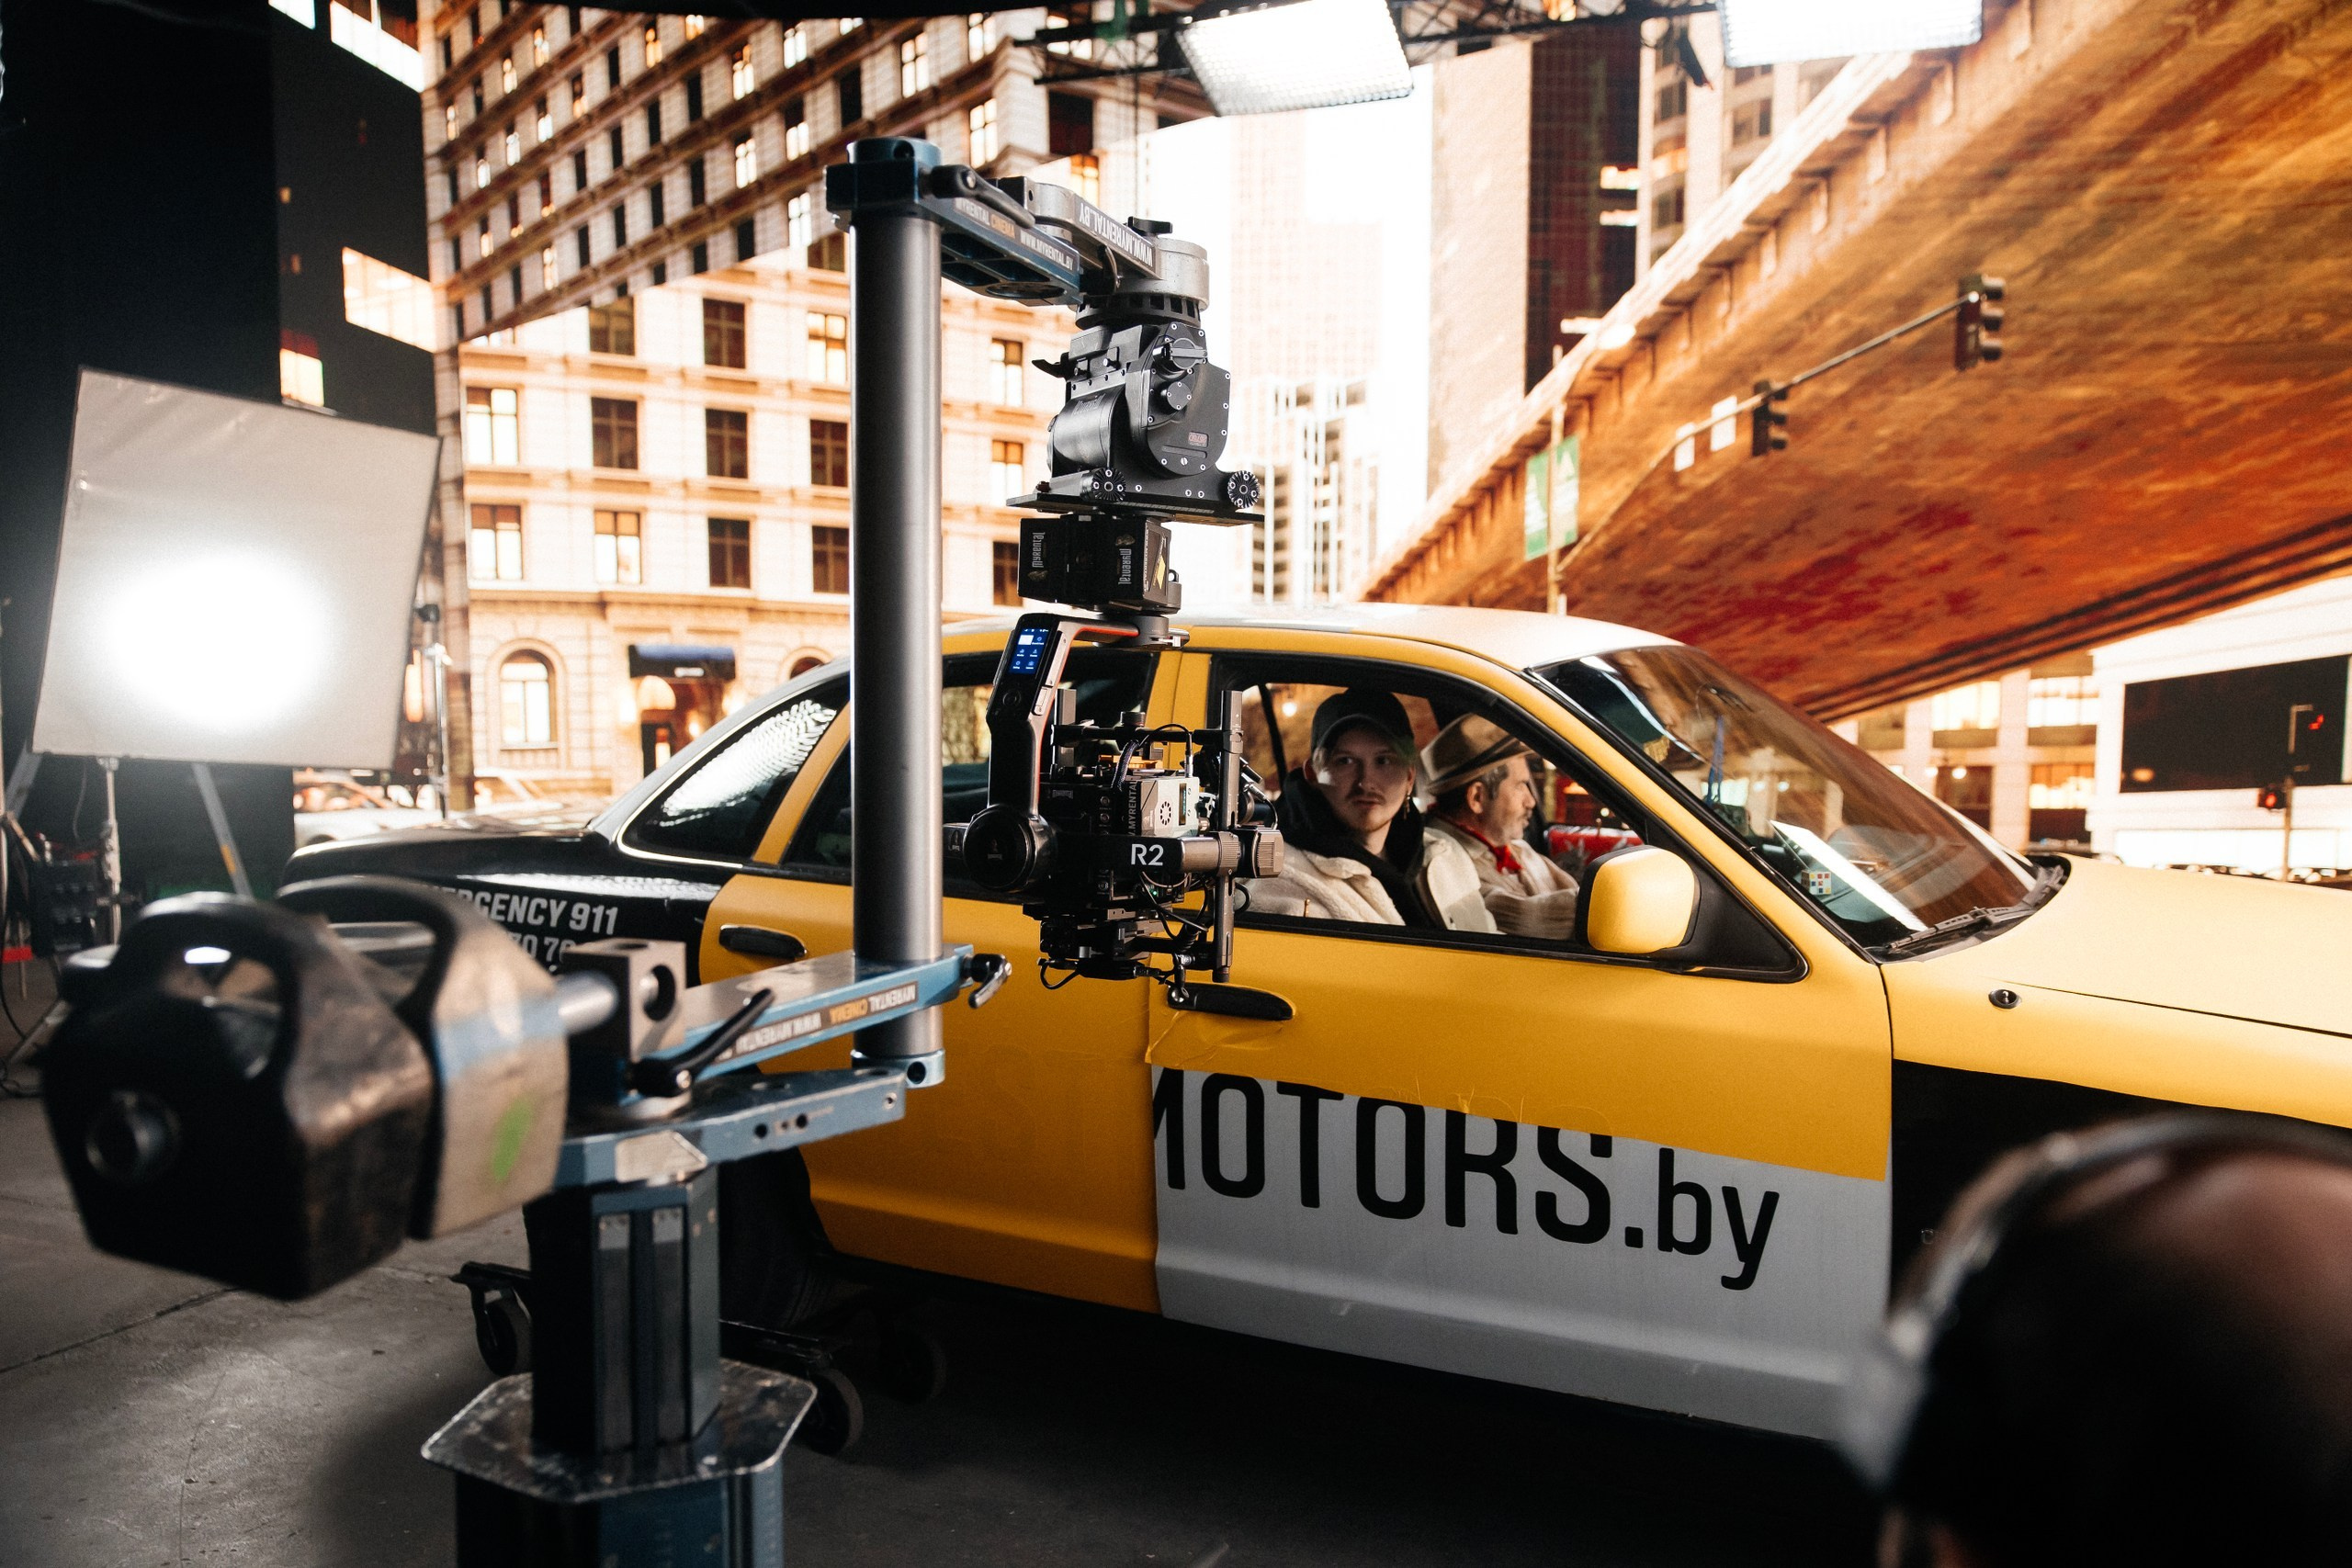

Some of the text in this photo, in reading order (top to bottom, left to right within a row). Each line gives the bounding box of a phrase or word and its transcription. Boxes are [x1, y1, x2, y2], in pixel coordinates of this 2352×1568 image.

[1020, 229, 1074, 270] WWW.MYRENTAL.BY
[1079, 202, 1153, 267] WWW.MYRENTAL.BY
[1130, 843, 1164, 866] R2
[568, 902, 618, 935] 911
